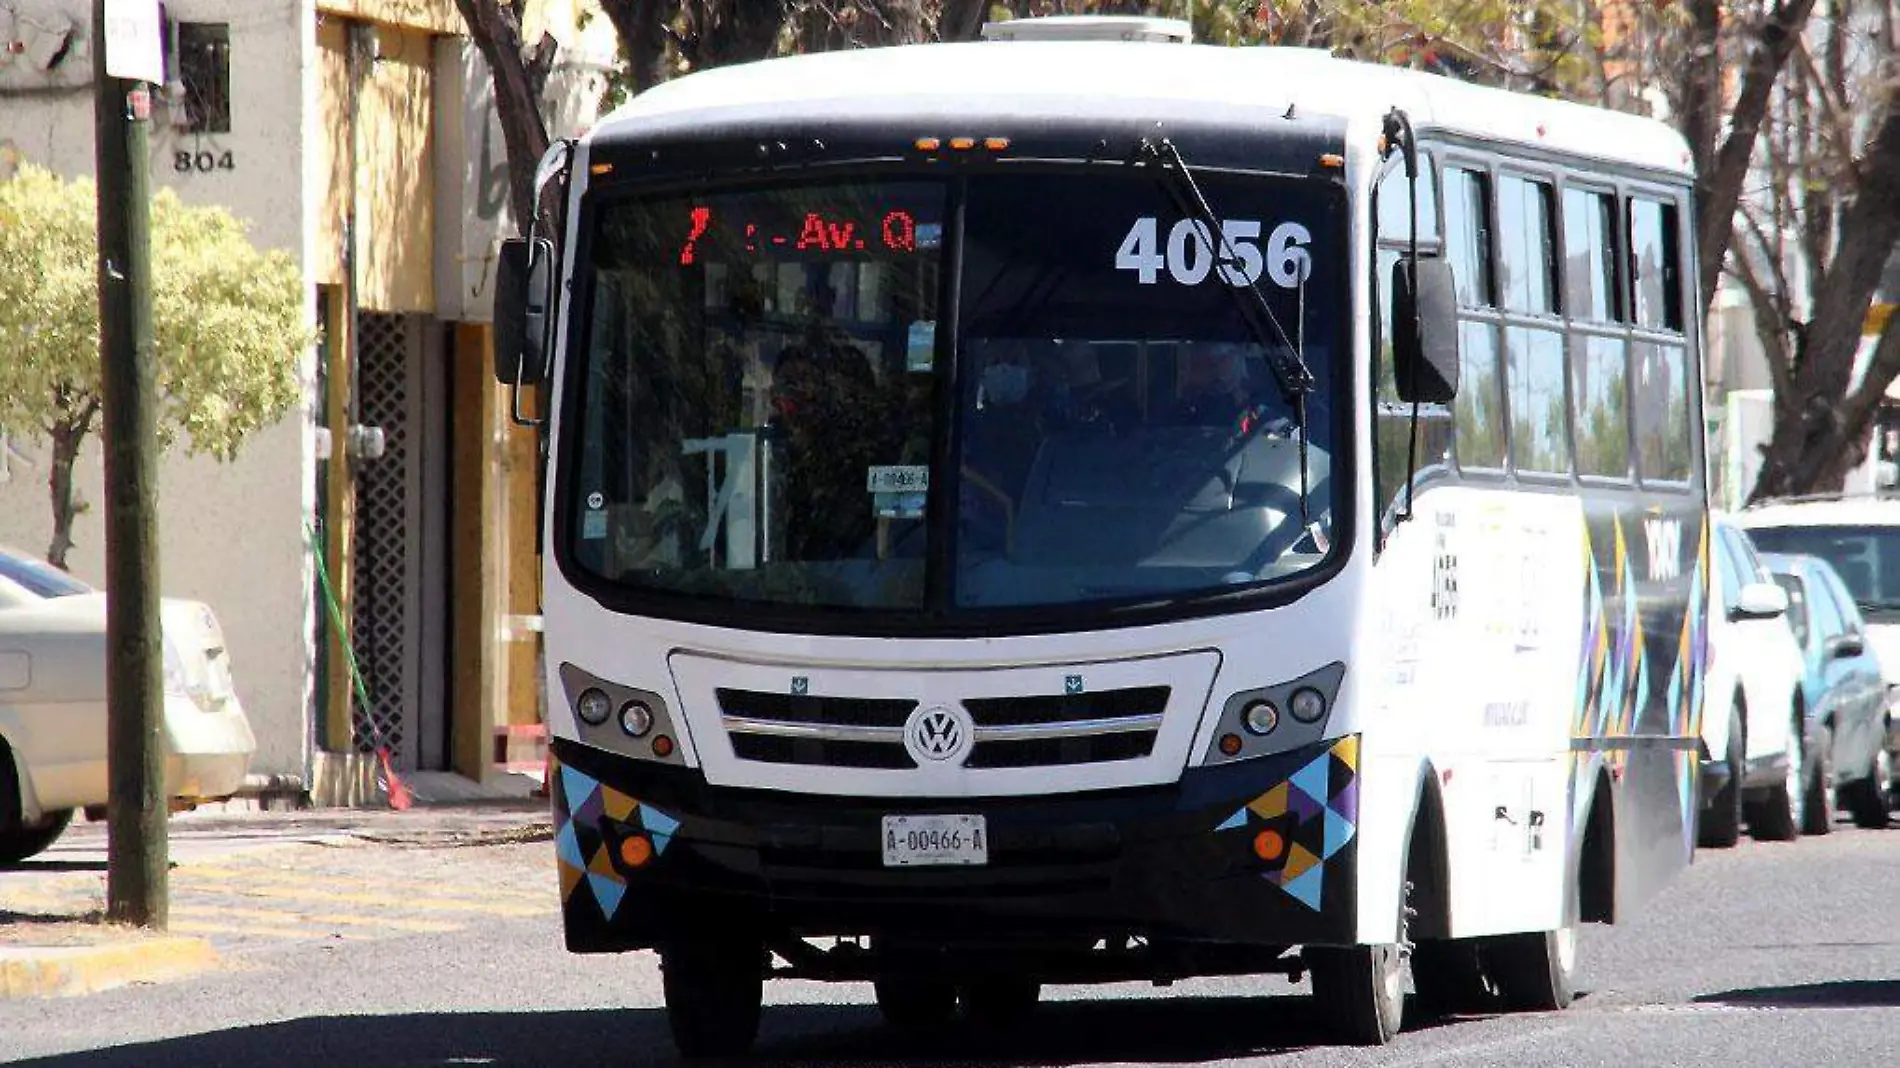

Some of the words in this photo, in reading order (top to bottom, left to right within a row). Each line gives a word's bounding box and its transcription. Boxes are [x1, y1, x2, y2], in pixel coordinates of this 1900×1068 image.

[174, 149, 234, 172] 804
[1115, 216, 1312, 288] 4056
[886, 828, 983, 851] A-00466-A
